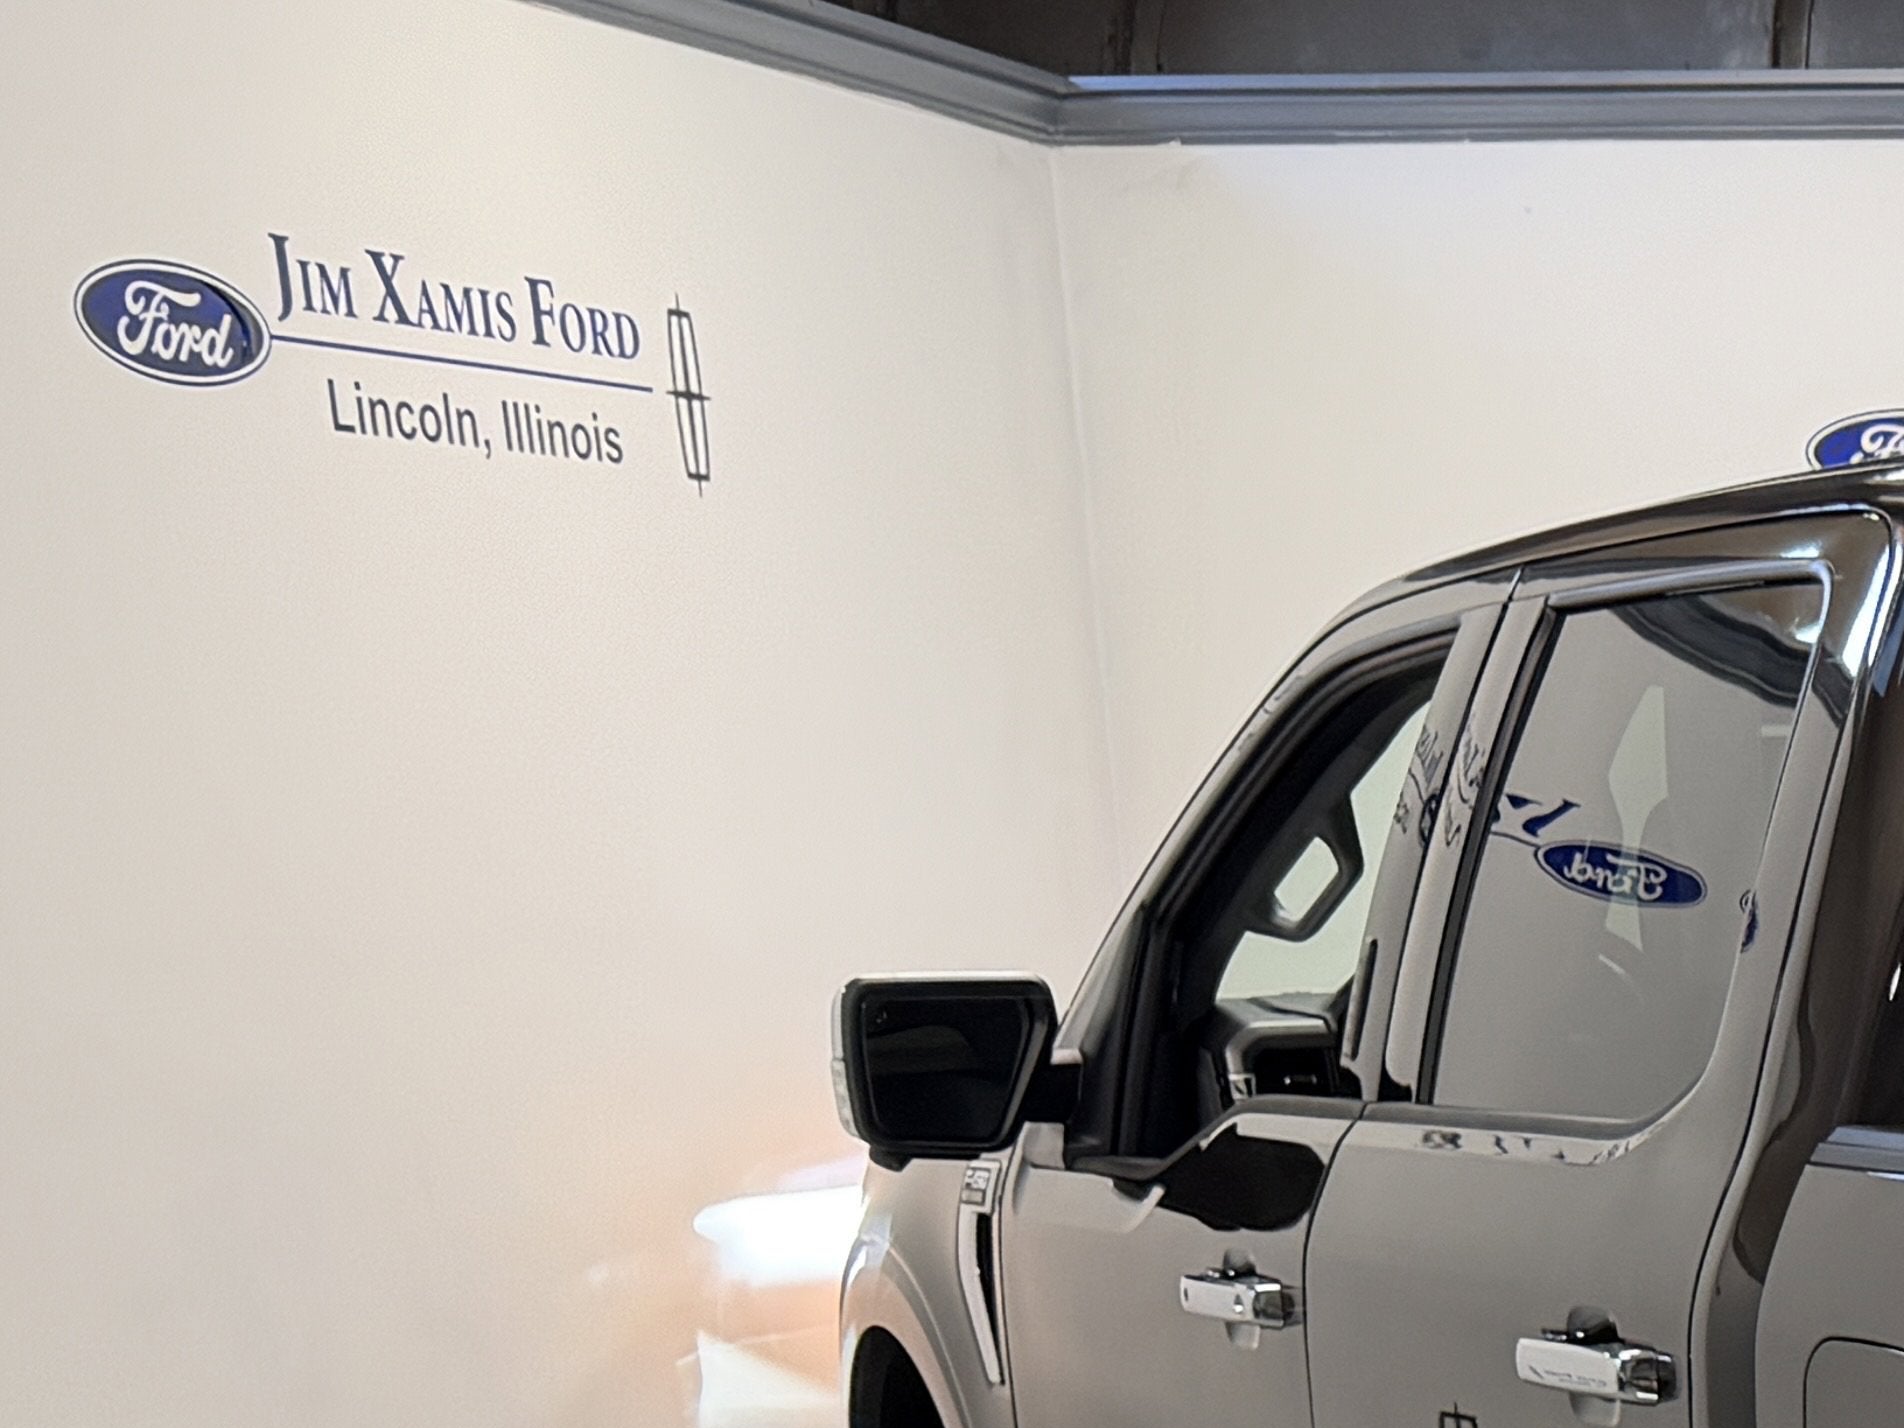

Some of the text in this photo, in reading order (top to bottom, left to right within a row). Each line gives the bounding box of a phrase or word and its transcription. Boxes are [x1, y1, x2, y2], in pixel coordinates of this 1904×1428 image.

[116, 280, 235, 369] Ford
[326, 377, 625, 465] Lincoln, Illinois
